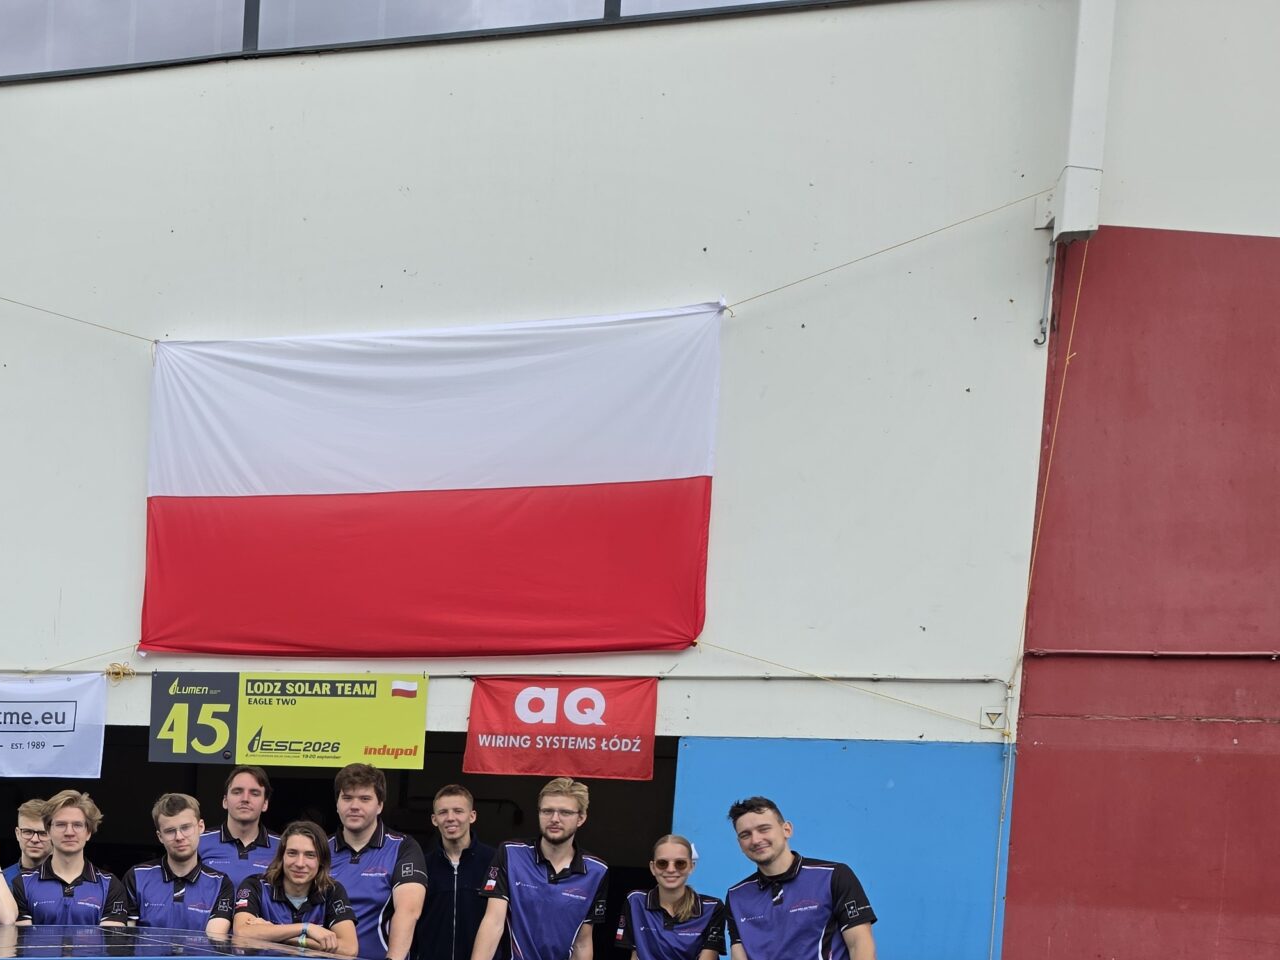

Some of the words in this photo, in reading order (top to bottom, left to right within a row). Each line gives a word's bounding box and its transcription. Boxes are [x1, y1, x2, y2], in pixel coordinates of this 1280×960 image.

[246, 681, 282, 695] LODZ
[285, 682, 331, 695] SOLAR
[336, 683, 376, 696] TEAM
[247, 698, 274, 706] EAGLE
[276, 698, 297, 706] TWO
[157, 703, 231, 754] 45
[27, 741, 46, 750] 1989
[478, 734, 531, 748] WIRING
[535, 735, 596, 750] SYSTEMS
[601, 735, 641, 752] ŁÓDŹ
[363, 745, 418, 759] indupol
